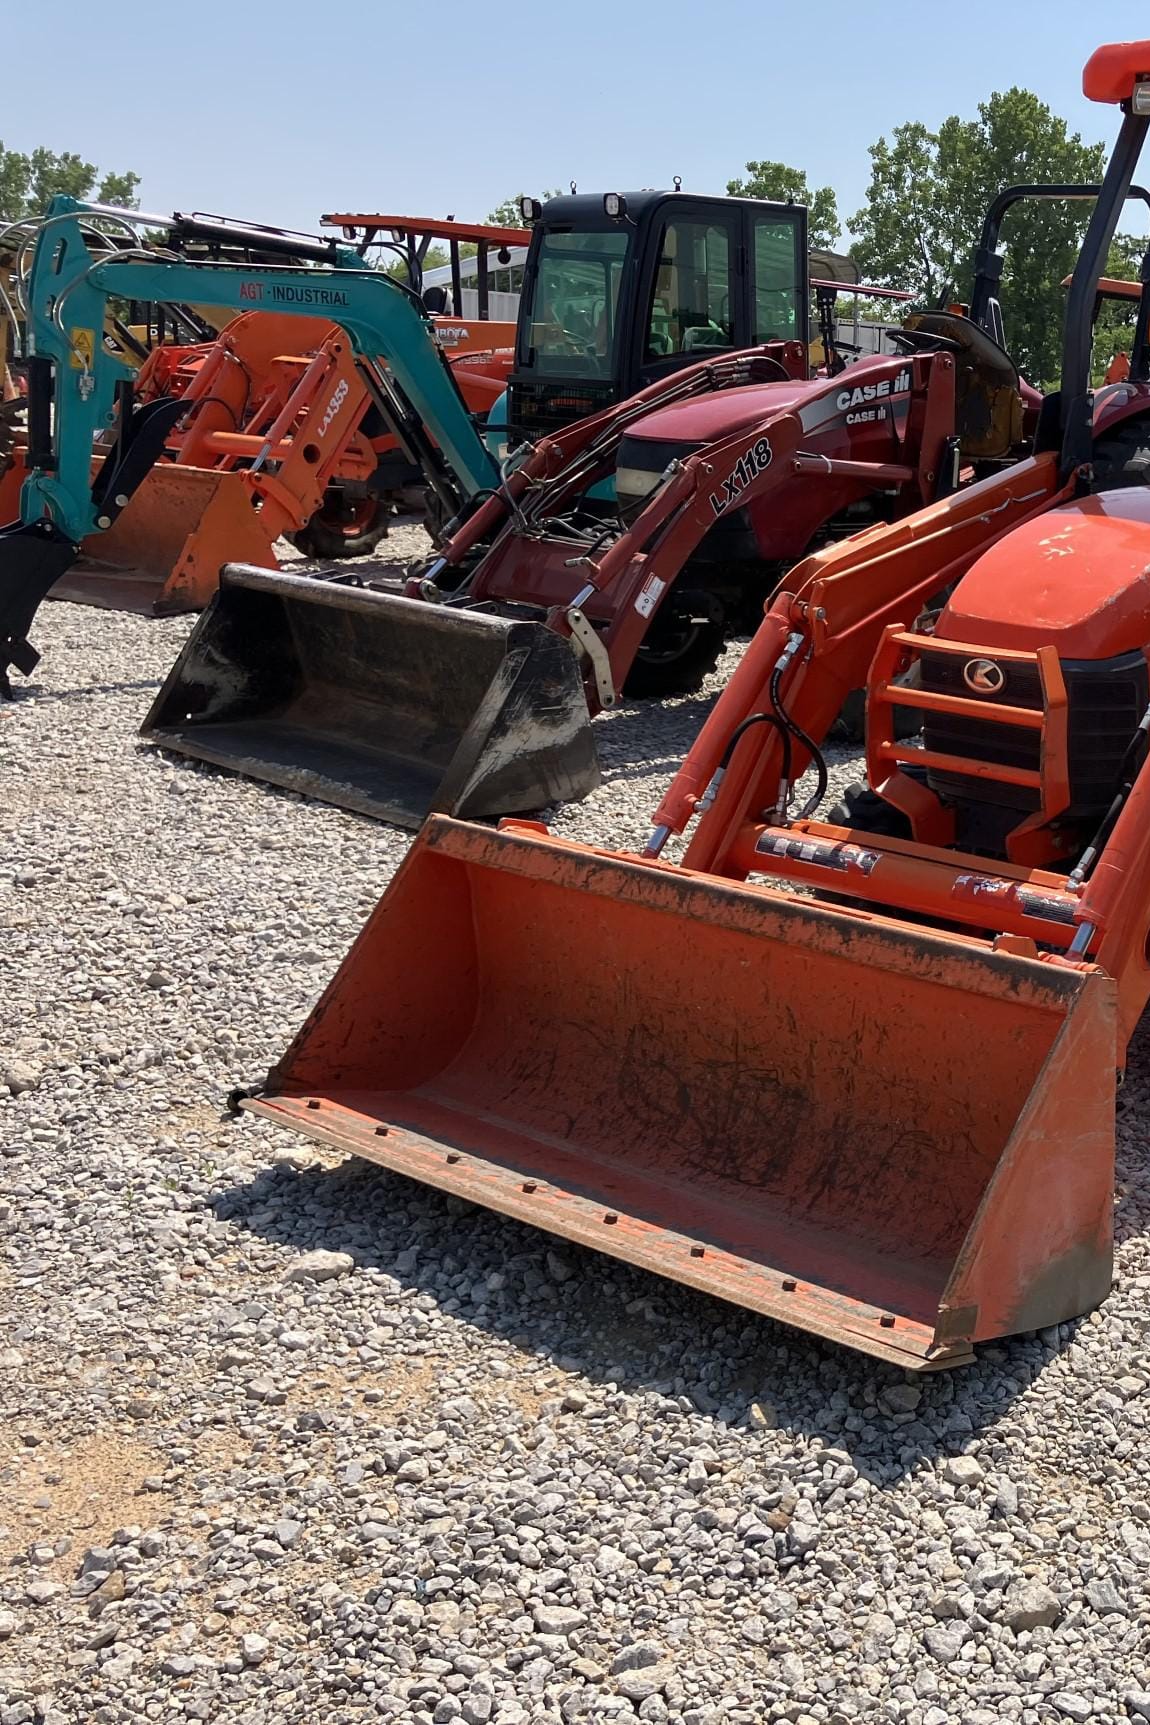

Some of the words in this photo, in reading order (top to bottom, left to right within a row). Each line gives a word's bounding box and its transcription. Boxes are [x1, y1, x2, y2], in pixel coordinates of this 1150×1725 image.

[240, 282, 264, 300] AGT
[272, 285, 350, 306] INDUSTRIAL
[104, 335, 118, 349] CAT
[836, 380, 891, 411] CASE
[846, 410, 876, 425] CASE
[709, 436, 773, 518] LX118
